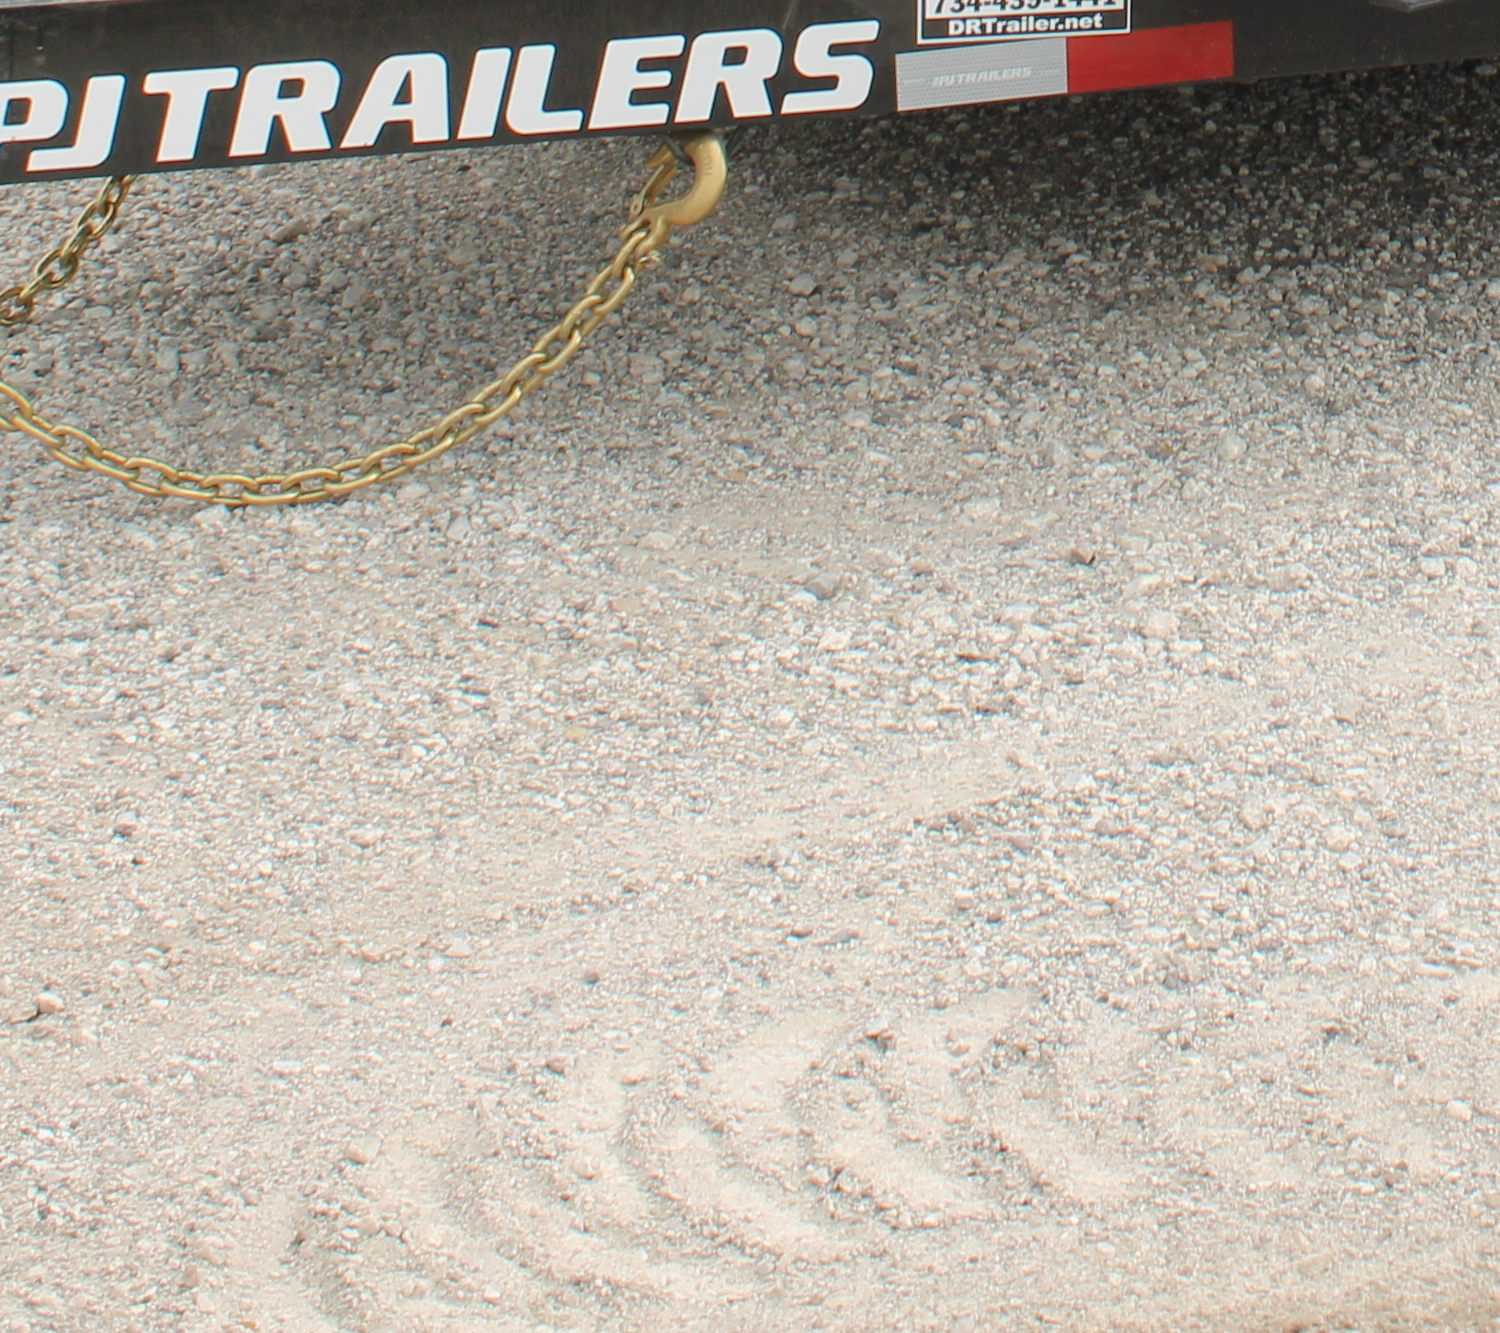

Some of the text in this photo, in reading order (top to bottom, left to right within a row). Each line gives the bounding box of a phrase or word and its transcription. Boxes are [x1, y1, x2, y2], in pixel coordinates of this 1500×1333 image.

[948, 12, 1104, 36] DRTrailer.net
[954, 66, 1033, 84] TRAILERS
[143, 19, 881, 163] TRAILERS
